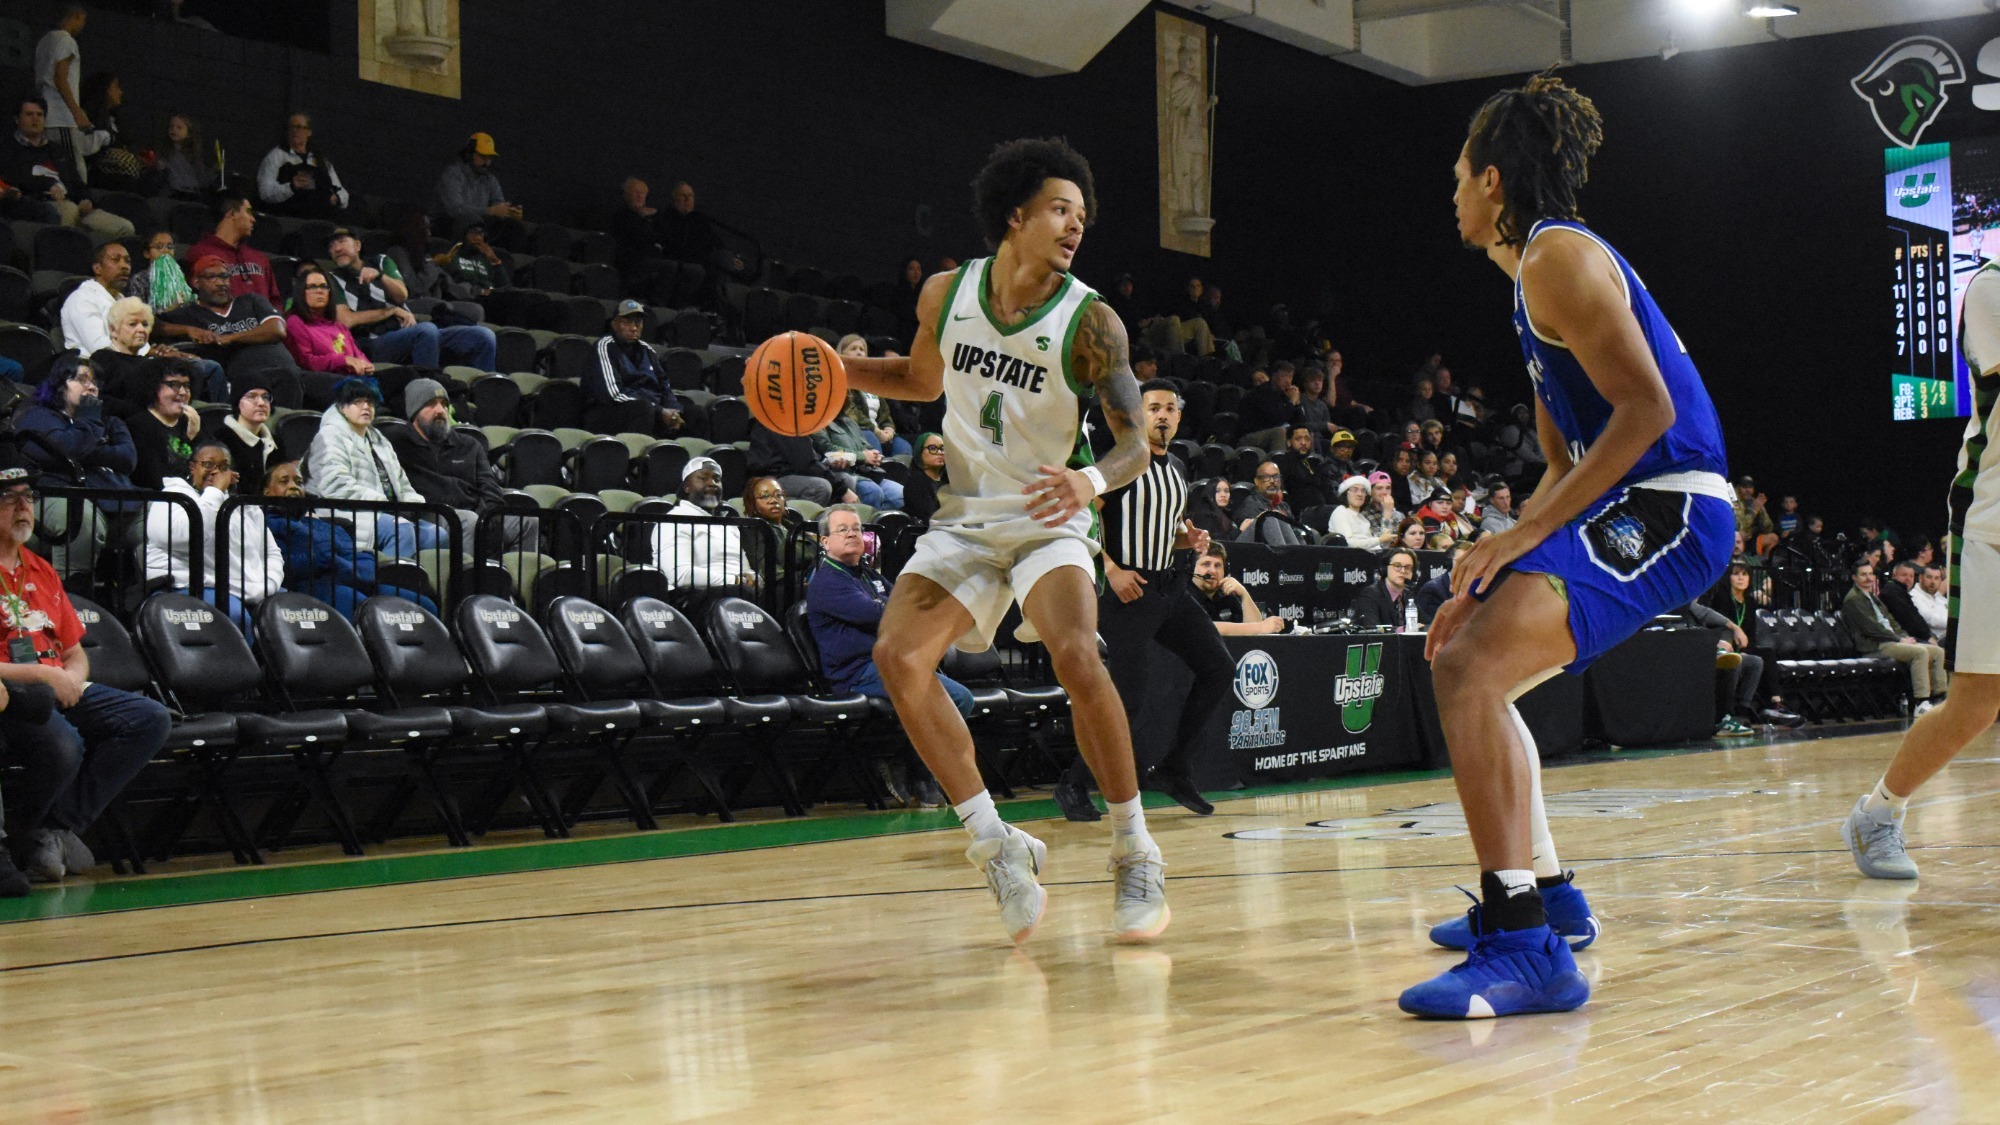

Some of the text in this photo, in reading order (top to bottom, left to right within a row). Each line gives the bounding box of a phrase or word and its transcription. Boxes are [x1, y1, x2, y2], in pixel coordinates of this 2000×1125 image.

[1893, 184, 1940, 199] Upstate
[1910, 245, 1929, 258] PTS
[1937, 244, 1944, 257] F
[1895, 262, 1944, 280] 1 5 1
[1892, 280, 1945, 299] 11 2 0
[1896, 300, 1946, 318] 2 0 0
[1896, 319, 1946, 336] 4 0 0
[1897, 338, 1947, 355] 7 0 0
[952, 342, 1048, 394] UPSTATE
[801, 347, 823, 415] Wilson
[1899, 383, 1914, 395] FG:
[1920, 382, 1927, 394] 5
[1894, 395, 1915, 408] 3PT:
[1921, 394, 1927, 406] 2
[1939, 393, 1946, 405] 3
[980, 390, 1004, 447] 4
[1894, 406, 1928, 420] REB: 3
[1243, 568, 1269, 586] ingles
[1343, 567, 1367, 584] ingles
[1430, 565, 1447, 579] ingl
[163, 608, 214, 624] Upstate
[281, 608, 329, 623] Upstate
[381, 610, 425, 625] Upstate
[480, 609, 520, 623] Upstate
[567, 610, 605, 624] Upstate
[640, 610, 674, 623] Upstate
[727, 611, 764, 624] Upstate
[1279, 604, 1304, 620] ingles
[1245, 663, 1268, 686] FOX
[1245, 686, 1269, 696] SPORTS
[1334, 671, 1384, 707] Upstate
[1231, 707, 1280, 735] 98.3FM
[1254, 742, 1366, 770] HOME OF THE SPARTANS
